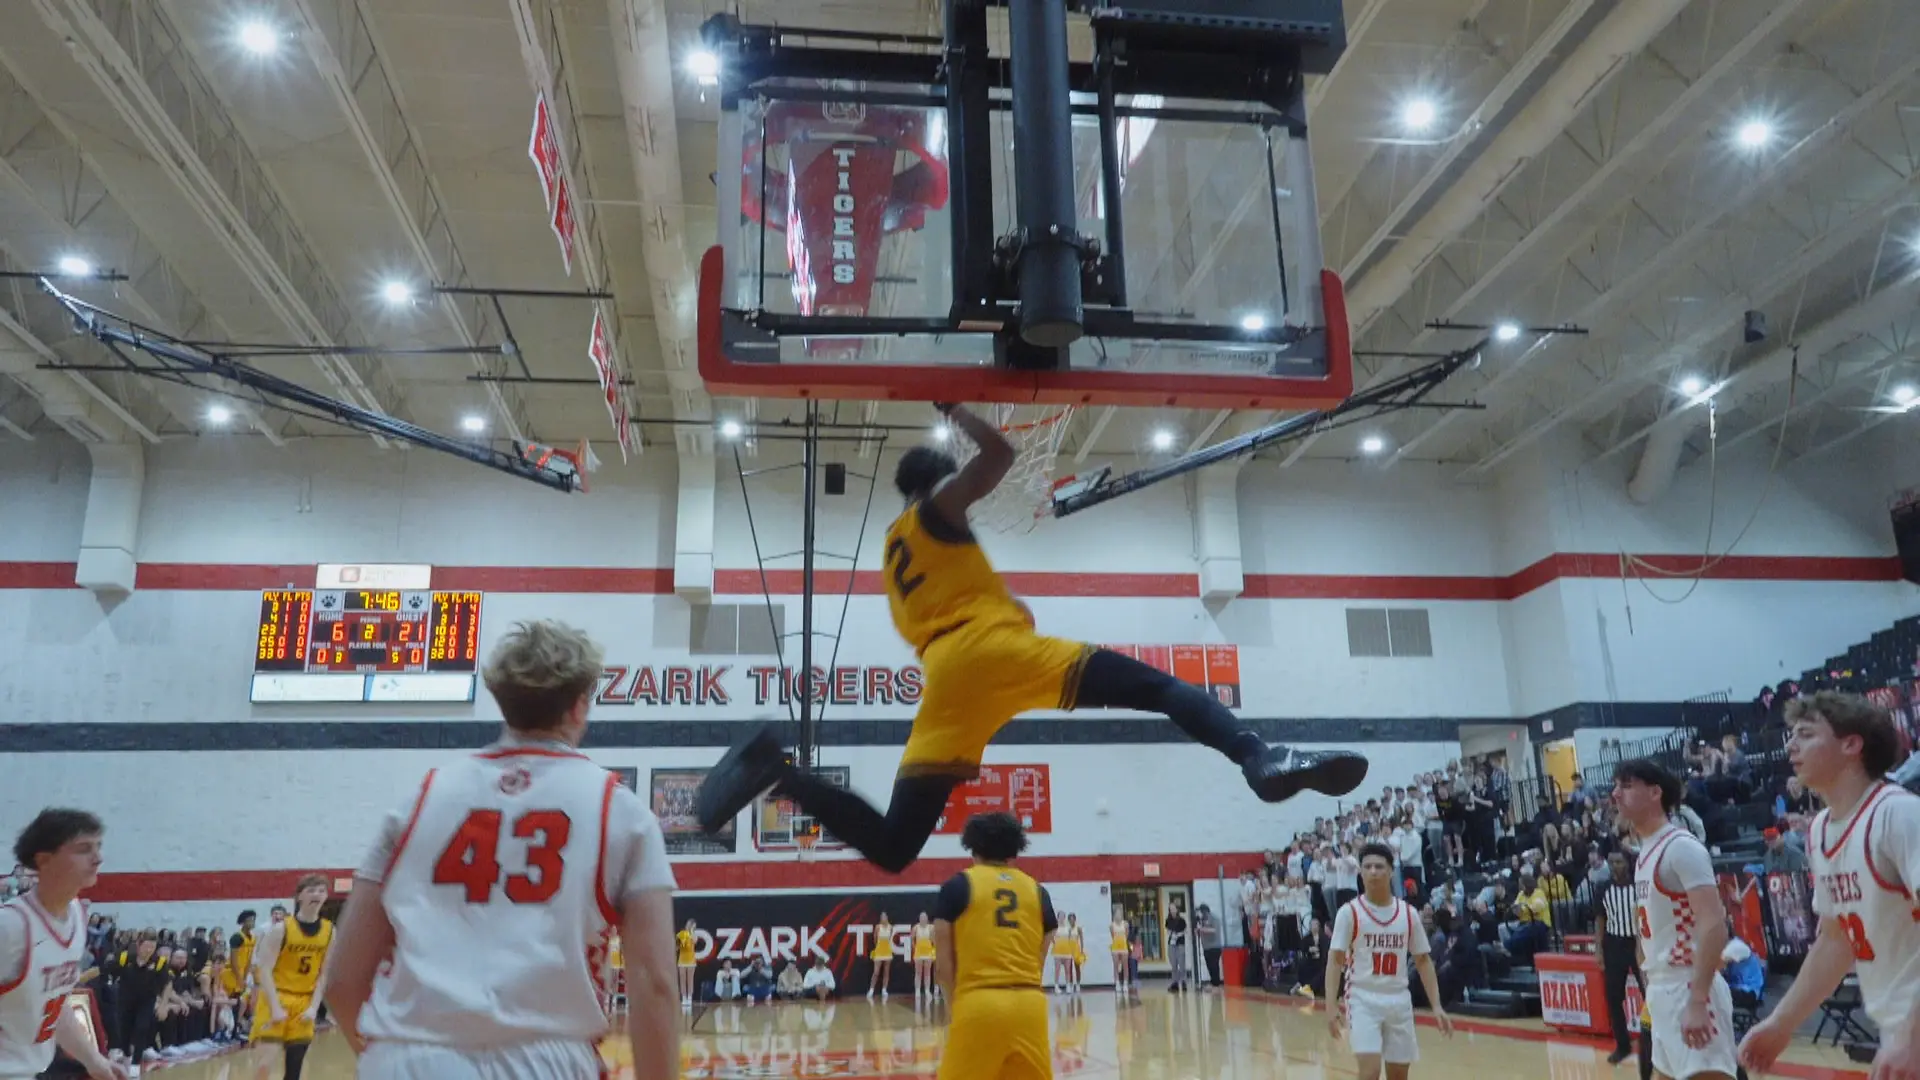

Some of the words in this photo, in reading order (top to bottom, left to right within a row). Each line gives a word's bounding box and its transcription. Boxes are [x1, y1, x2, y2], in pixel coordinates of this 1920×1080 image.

[832, 147, 856, 284] TIGERS
[888, 536, 926, 600] 2
[301, 602, 308, 613] 0
[359, 591, 399, 610] 7:46
[270, 613, 278, 623] 4
[300, 614, 307, 623] 0
[261, 624, 276, 635] 23
[298, 624, 306, 636] 0
[332, 623, 344, 641] 6
[398, 623, 424, 641] 21
[297, 636, 305, 648] 0
[296, 648, 303, 659] 6
[317, 648, 327, 664] 0
[411, 648, 420, 664] 0
[466, 648, 473, 660] 0
[593, 665, 733, 705] ZARK
[747, 665, 924, 705] TIGERS
[433, 808, 570, 903] 43
[994, 887, 1019, 928] 2
[694, 925, 829, 964] OZARK
[1364, 933, 1404, 949] TIGERS
[298, 955, 313, 975] 5
[1372, 952, 1397, 976] 10
[1543, 981, 1590, 1012] OZARK
